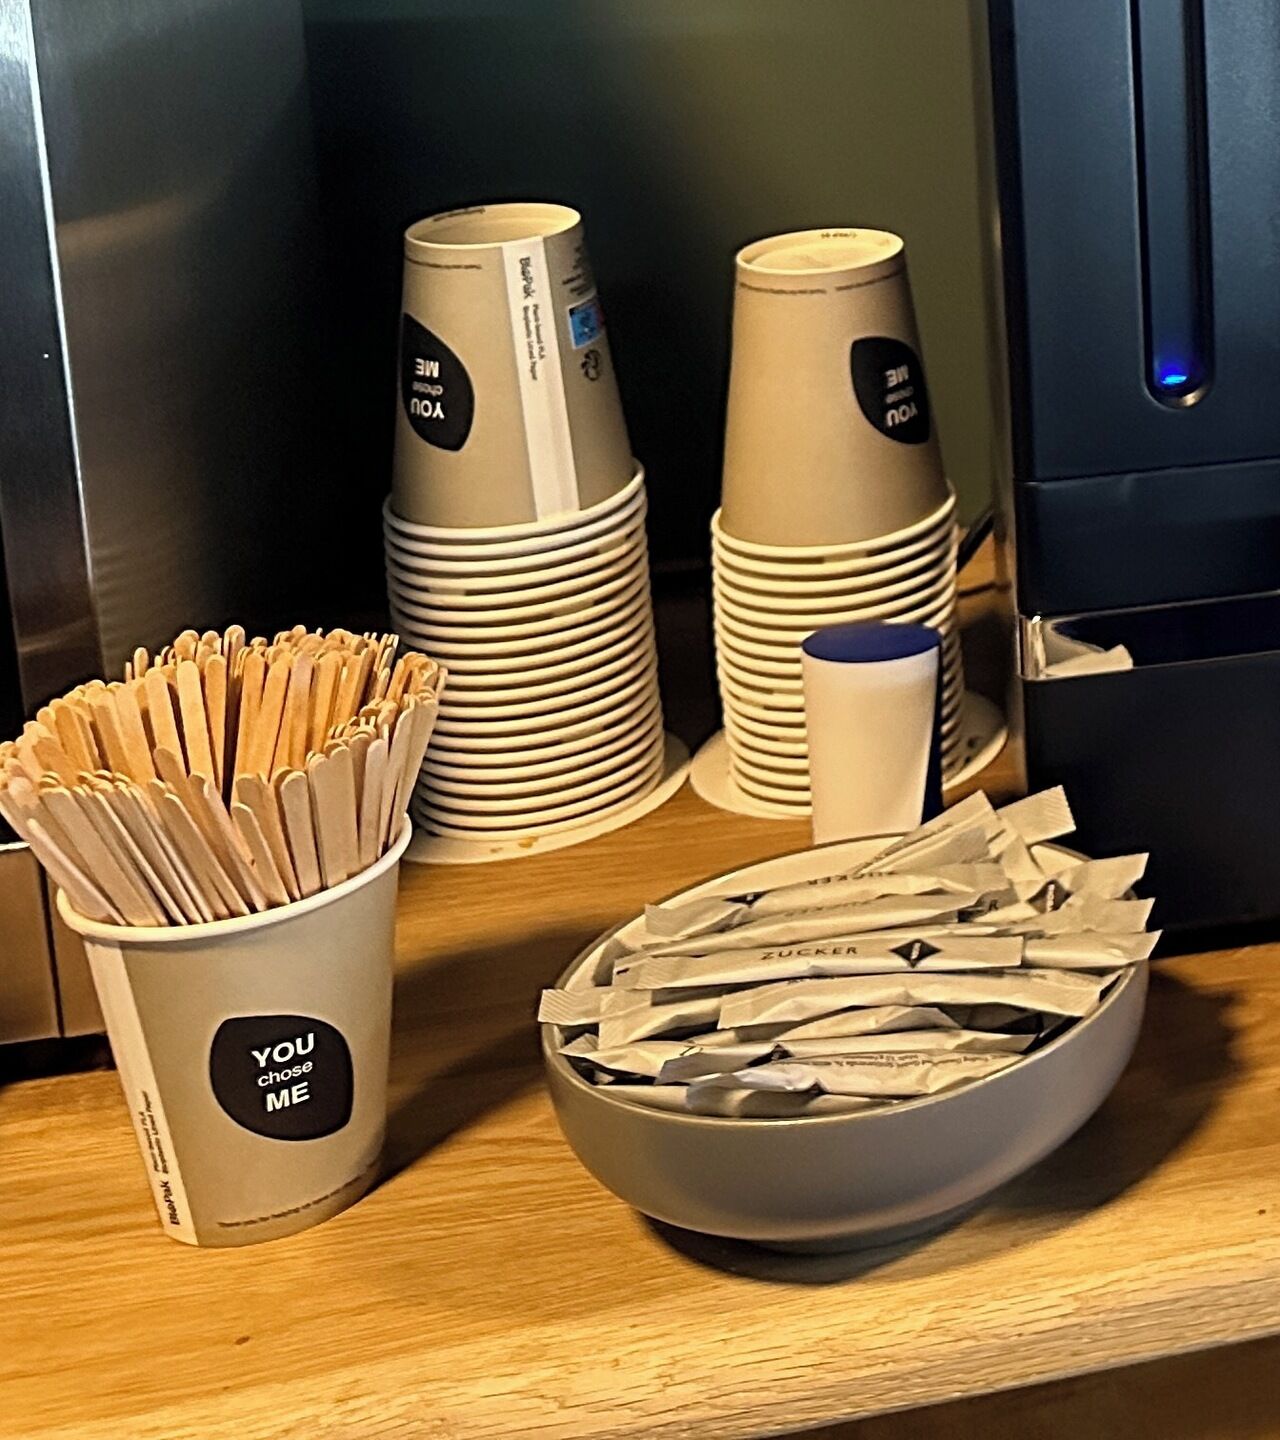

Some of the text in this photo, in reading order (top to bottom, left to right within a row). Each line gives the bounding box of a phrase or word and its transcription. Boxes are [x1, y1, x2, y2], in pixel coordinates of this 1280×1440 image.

[413, 356, 440, 379] ME
[410, 397, 446, 420] YOU
[760, 946, 858, 961] ZUCKER
[251, 1032, 315, 1068] YOU
[257, 1061, 313, 1087] chose
[266, 1081, 310, 1112] ME
